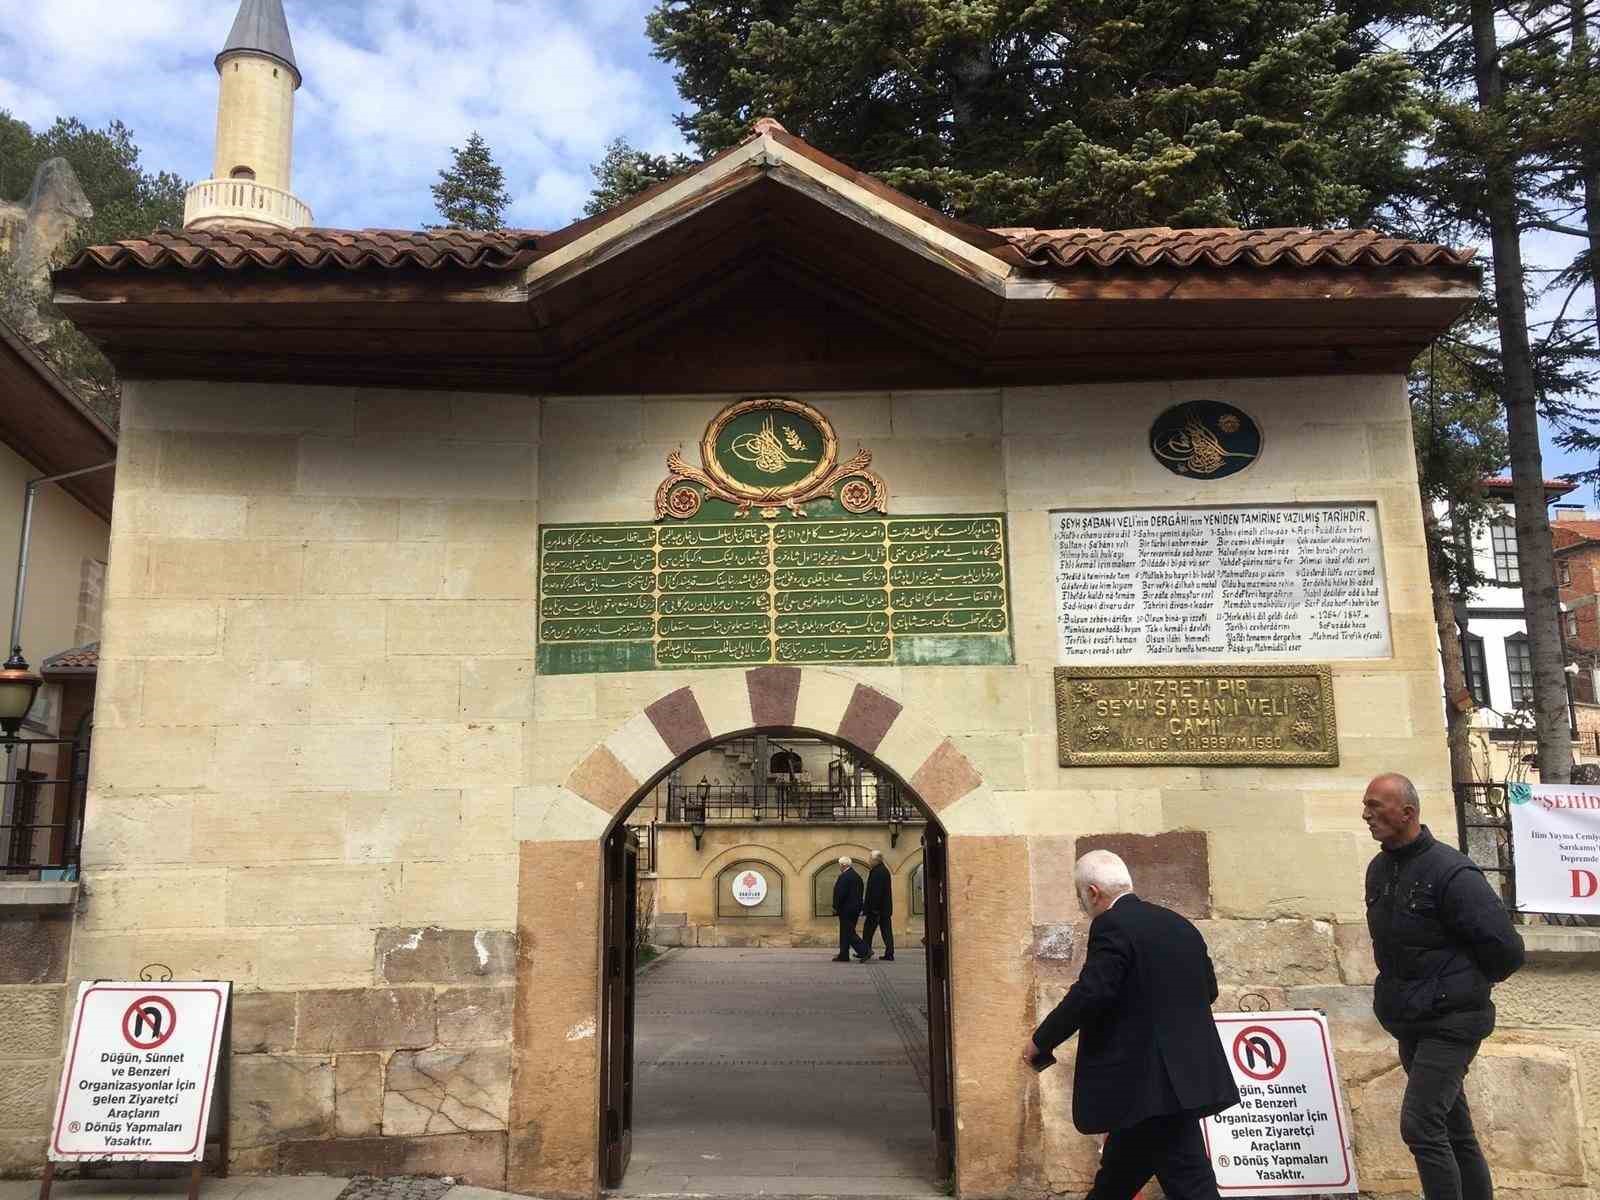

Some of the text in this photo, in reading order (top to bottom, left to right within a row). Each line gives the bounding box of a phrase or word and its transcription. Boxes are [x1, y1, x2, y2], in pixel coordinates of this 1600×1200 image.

[101, 1052, 184, 1065] Düğün, Sünnet
[112, 1066, 171, 1076] ve Benzeri
[79, 1080, 196, 1092] Organizasyonlar İçin
[1238, 1083, 1307, 1096] ğün, Sünnet
[93, 1093, 179, 1106] gelen Ziyaretçi
[1240, 1098, 1297, 1109] ve Benzeri
[107, 1108, 160, 1120] Araçların
[1214, 1109, 1328, 1125] Organizasyonlar İçin
[85, 1122, 182, 1135] Dönüş Yapmaları
[1231, 1125, 1315, 1139] gelen Ziyaretçi
[105, 1136, 152, 1147] Yasaktır.
[1251, 1140, 1301, 1152] Araçların
[1234, 1154, 1328, 1167] Dönüş Yapmaları
[1257, 1169, 1305, 1180] Yasaktır.
